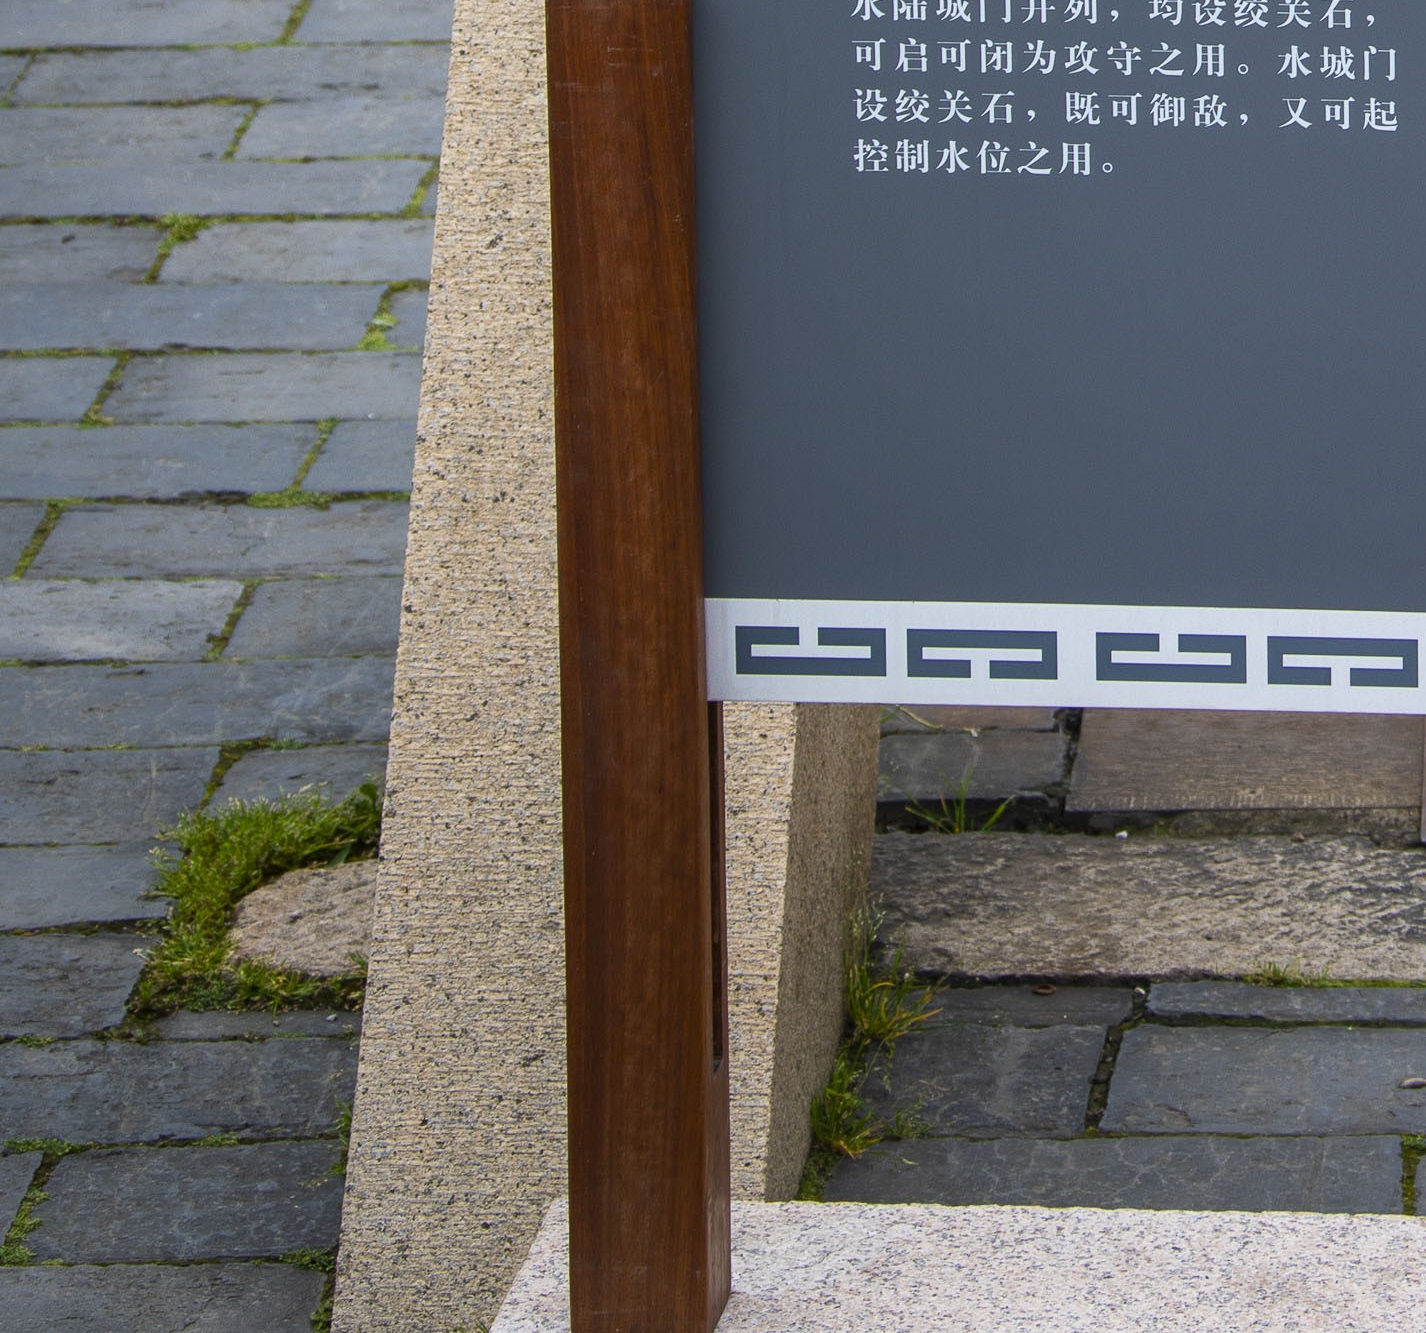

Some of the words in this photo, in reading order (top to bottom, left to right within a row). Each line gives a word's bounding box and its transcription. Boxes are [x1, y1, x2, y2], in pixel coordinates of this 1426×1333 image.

[851, 37, 1397, 82] 可启可闭为攻守之用。水城门
[852, 88, 1399, 132] 设绞关石，既可御敌，又可起
[853, 138, 1114, 176] 控制水位之用。
